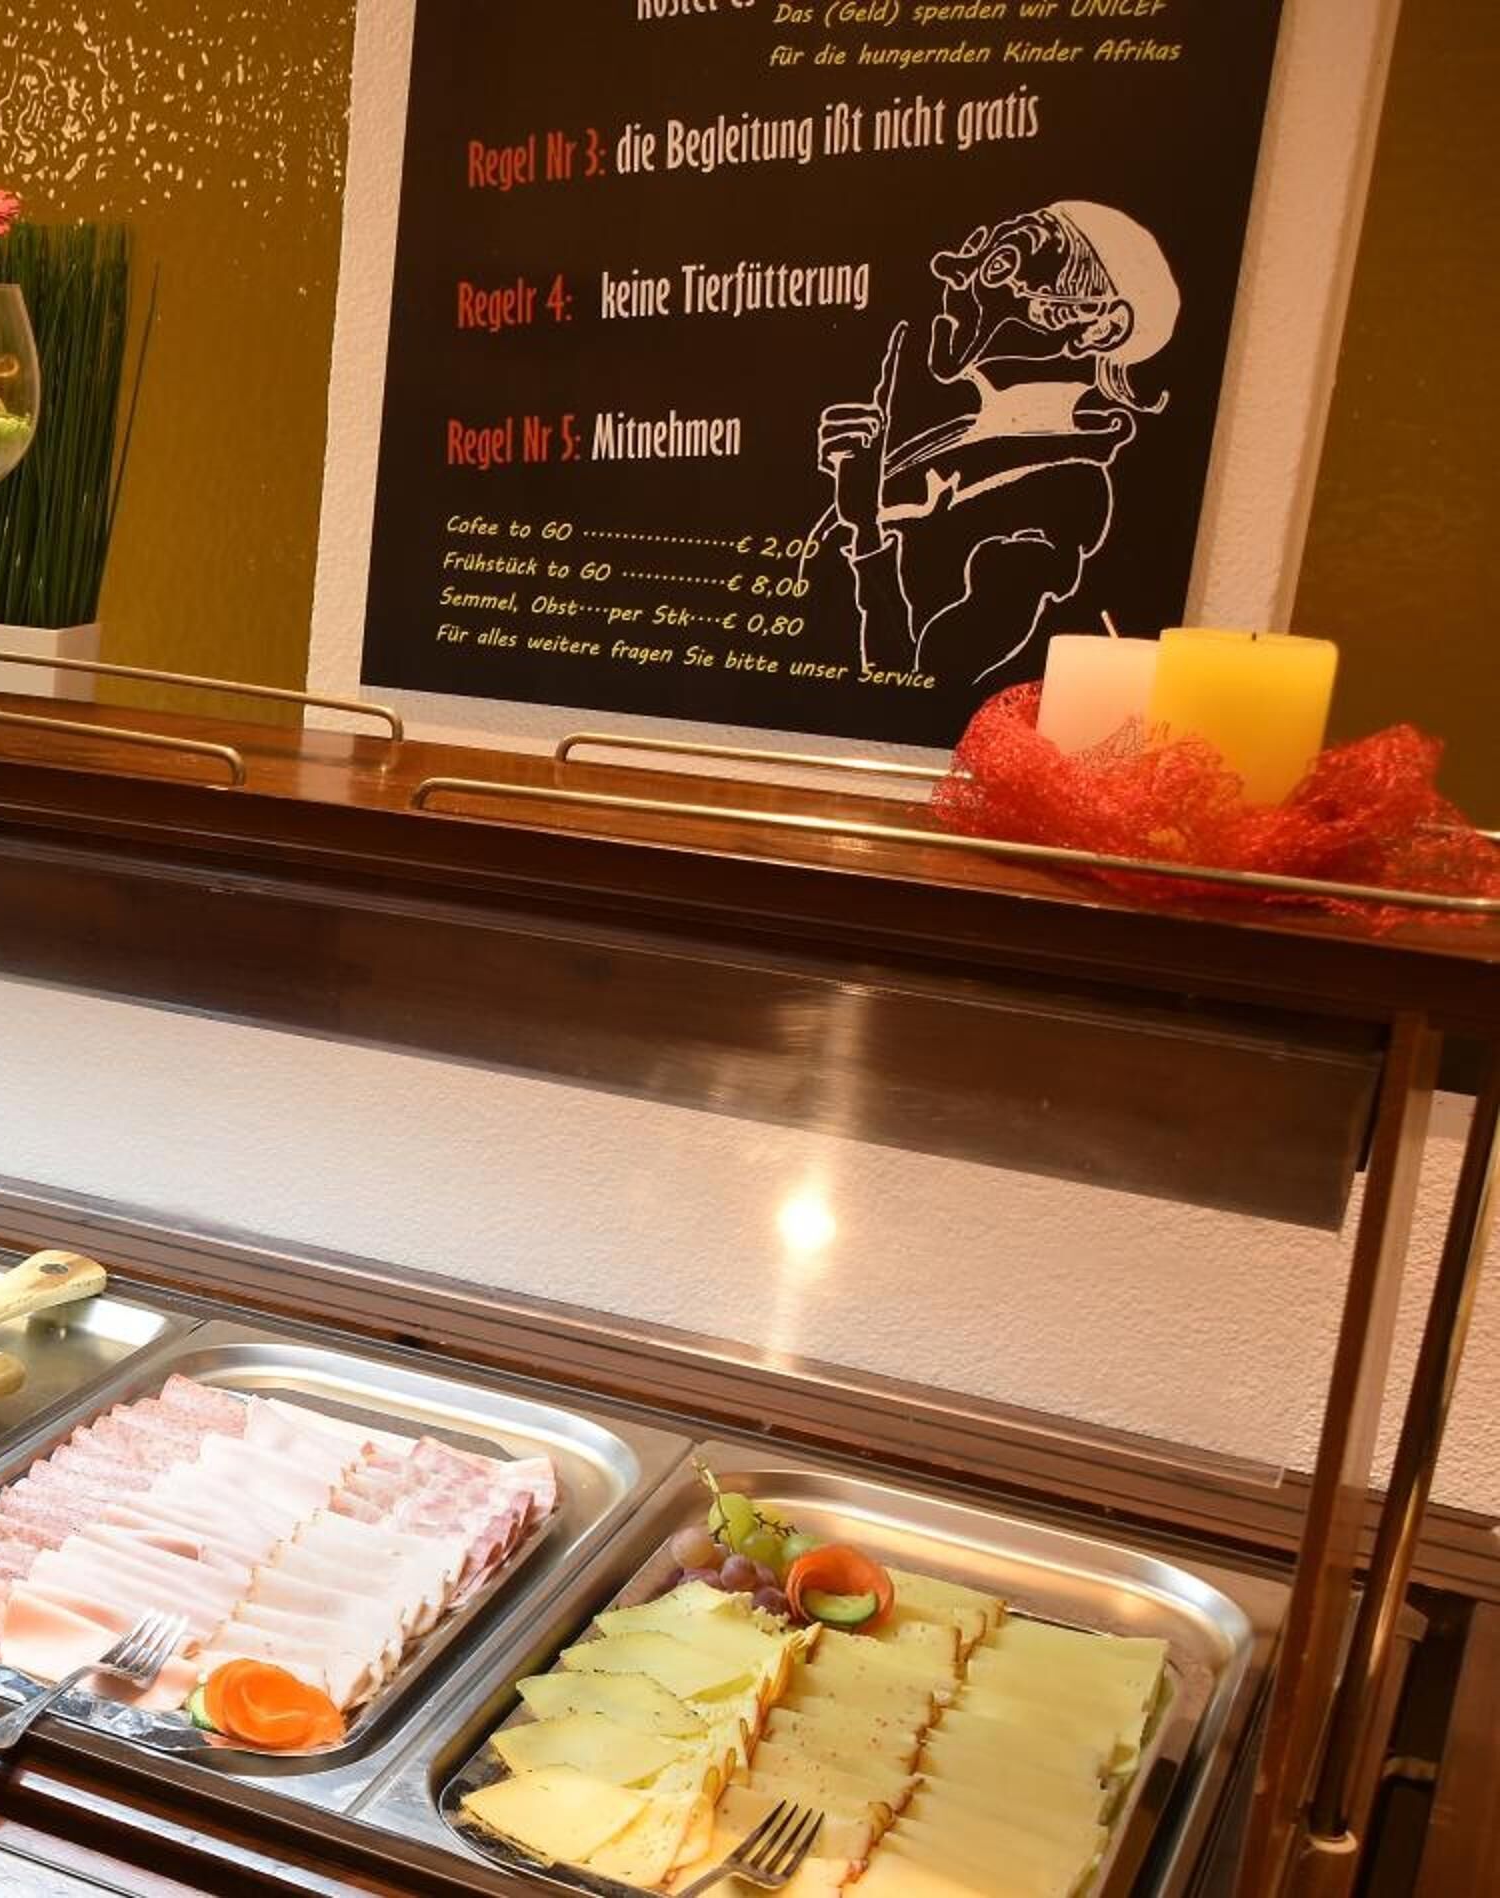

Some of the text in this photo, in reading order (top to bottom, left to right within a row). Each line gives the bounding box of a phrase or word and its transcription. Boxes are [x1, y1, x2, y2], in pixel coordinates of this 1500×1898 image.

[773, 3, 814, 23] Das
[824, 0, 899, 28] (Geld)
[913, 1, 1006, 26] spenden
[1020, 0, 1058, 18] wir
[1071, 0, 1165, 17] UNICEF
[770, 39, 1181, 69] für die hungernden Kinder Afrikas
[469, 84, 1039, 191] Regel Nr 3: die Begleitung ißt nicht gratis
[459, 261, 869, 332] Regelr 4: keine Tierfütterung
[448, 410, 740, 469] Regel Nr 5: Mitnehmen
[447, 516, 819, 561] Cofee to GO € 2,00
[444, 552, 809, 597] Frühstück to GO € 8,00
[440, 586, 804, 636] Semmel, Obst per Stk € 0,80
[437, 624, 935, 688] Für alles weitere fragen Sie bitte unser Service
